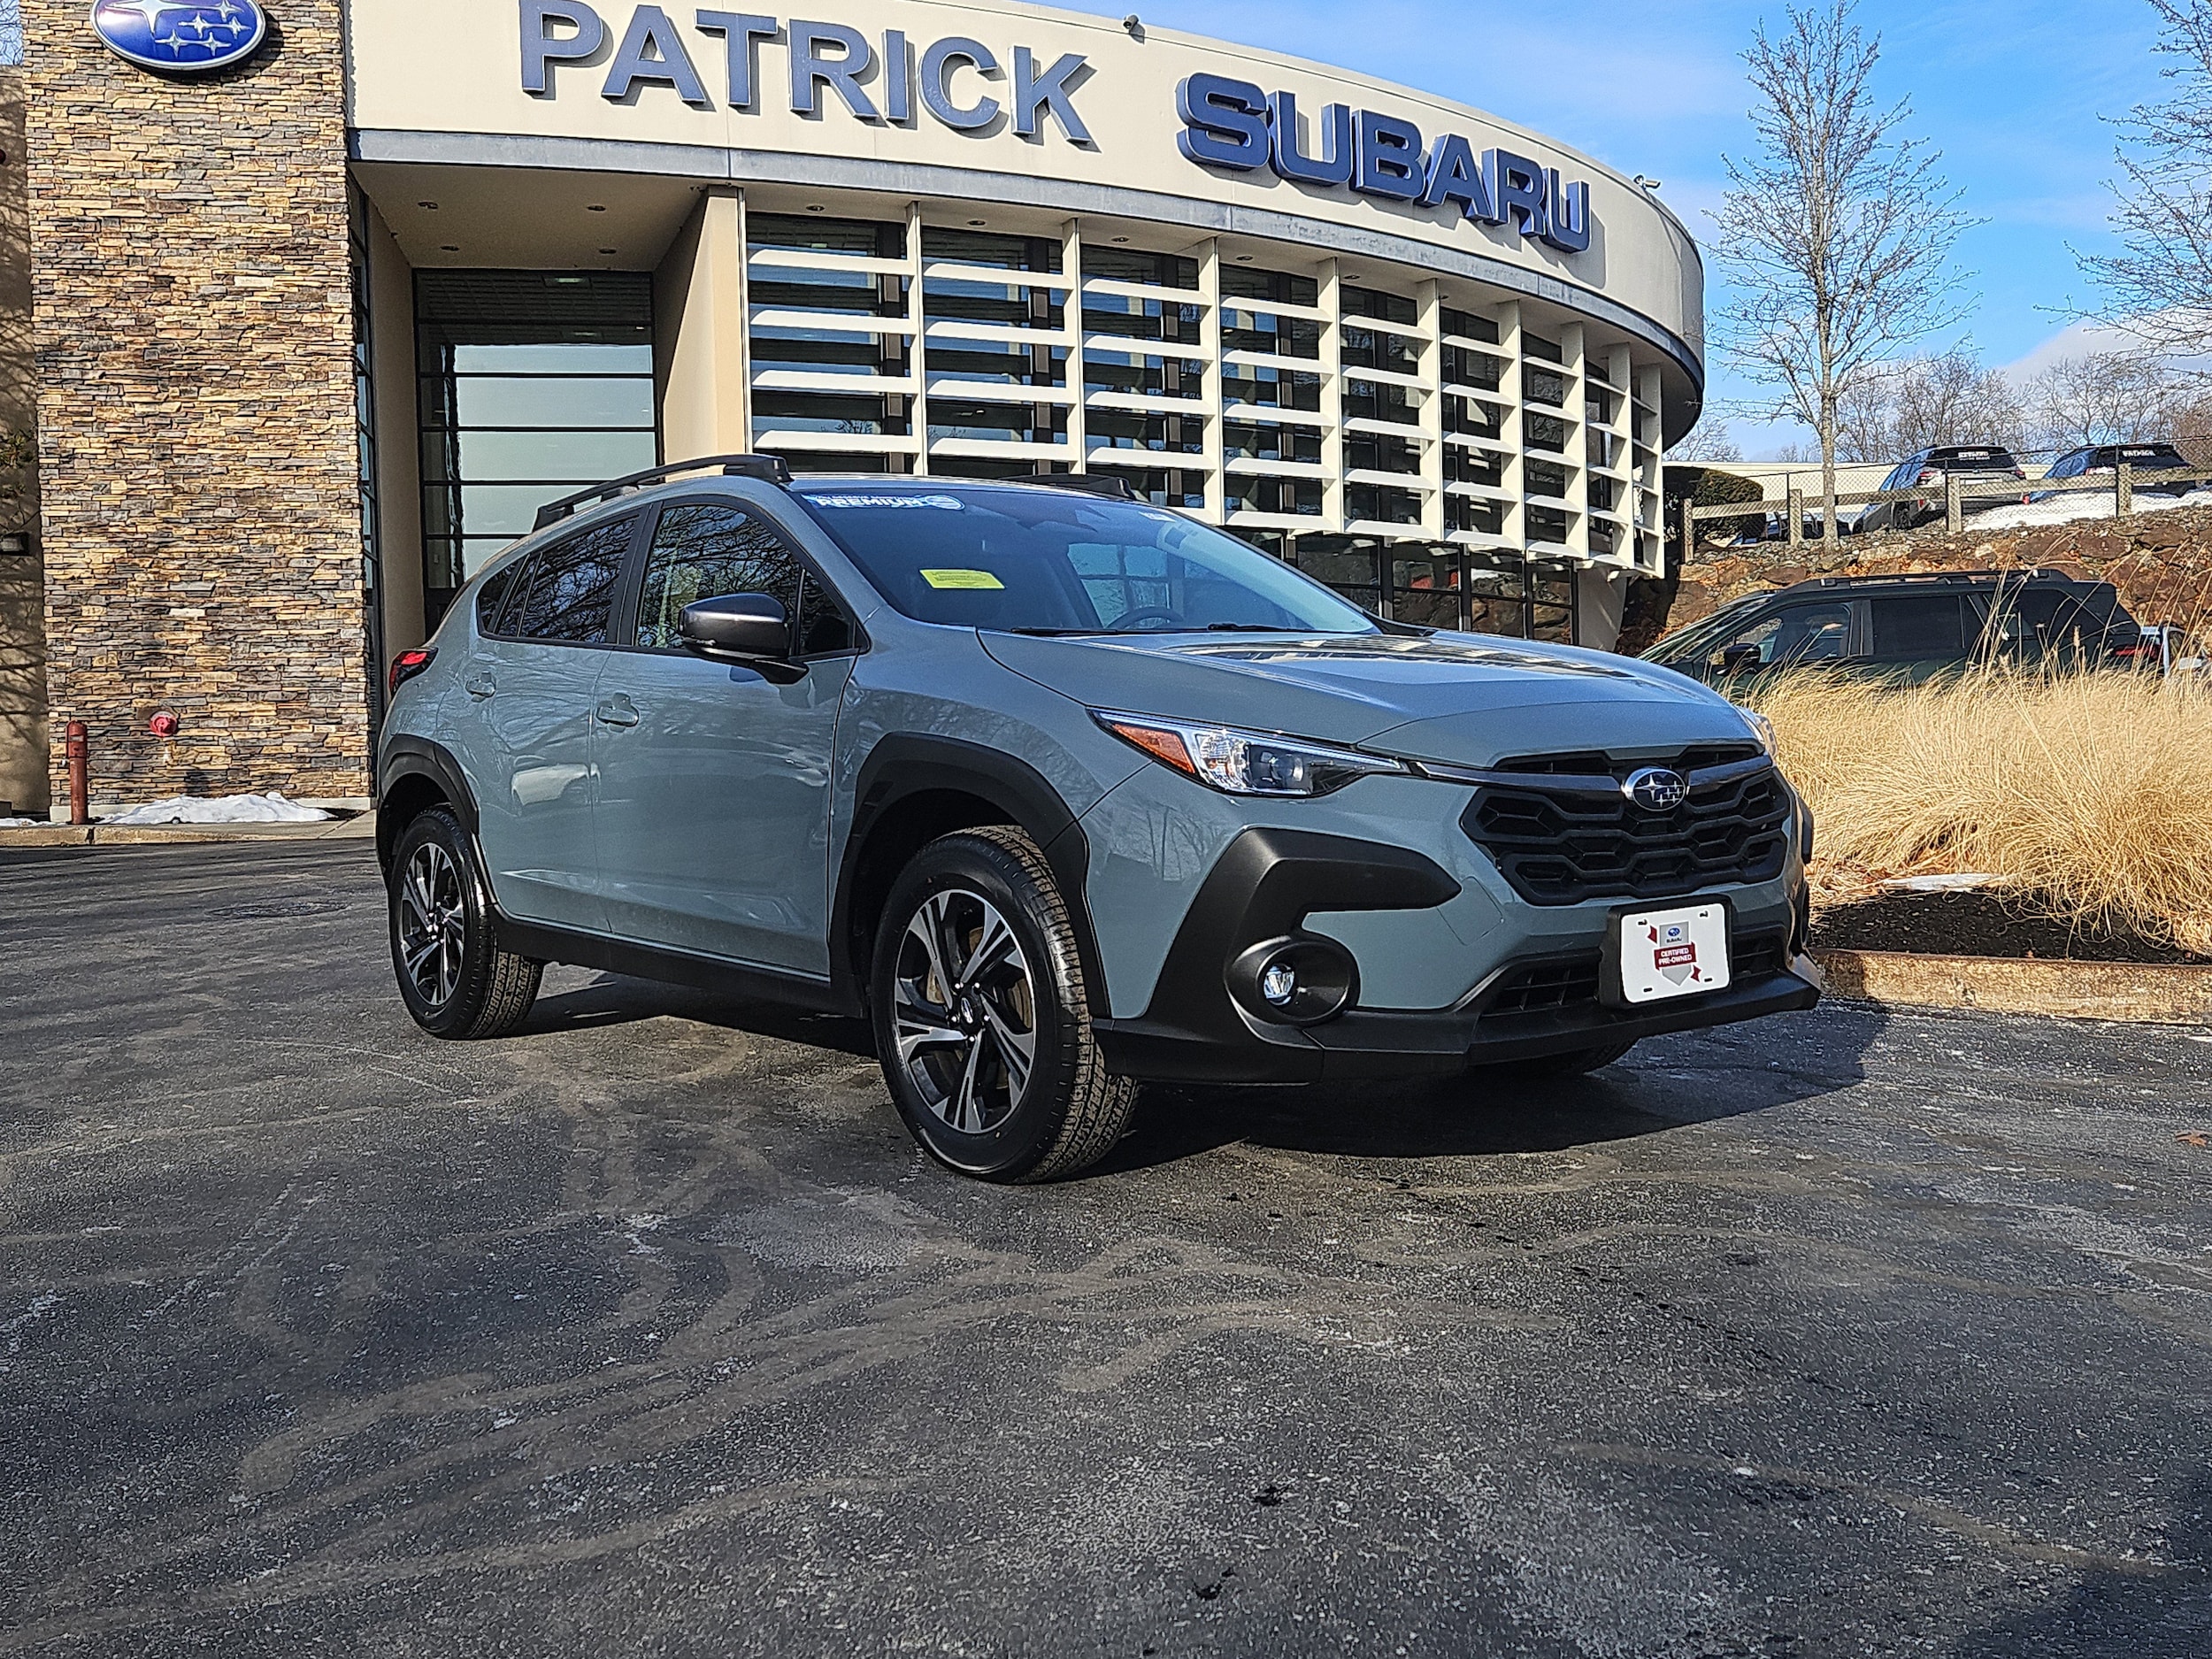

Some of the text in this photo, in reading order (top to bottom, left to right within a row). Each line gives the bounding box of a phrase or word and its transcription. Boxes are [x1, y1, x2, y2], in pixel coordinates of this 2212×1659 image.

[518, 0, 1591, 254] PATRICK SUBARU
[816, 495, 924, 508] PREMIUM
[1661, 948, 1689, 957] CERTIFIED
[1658, 954, 1692, 964] PRE-OWNED
